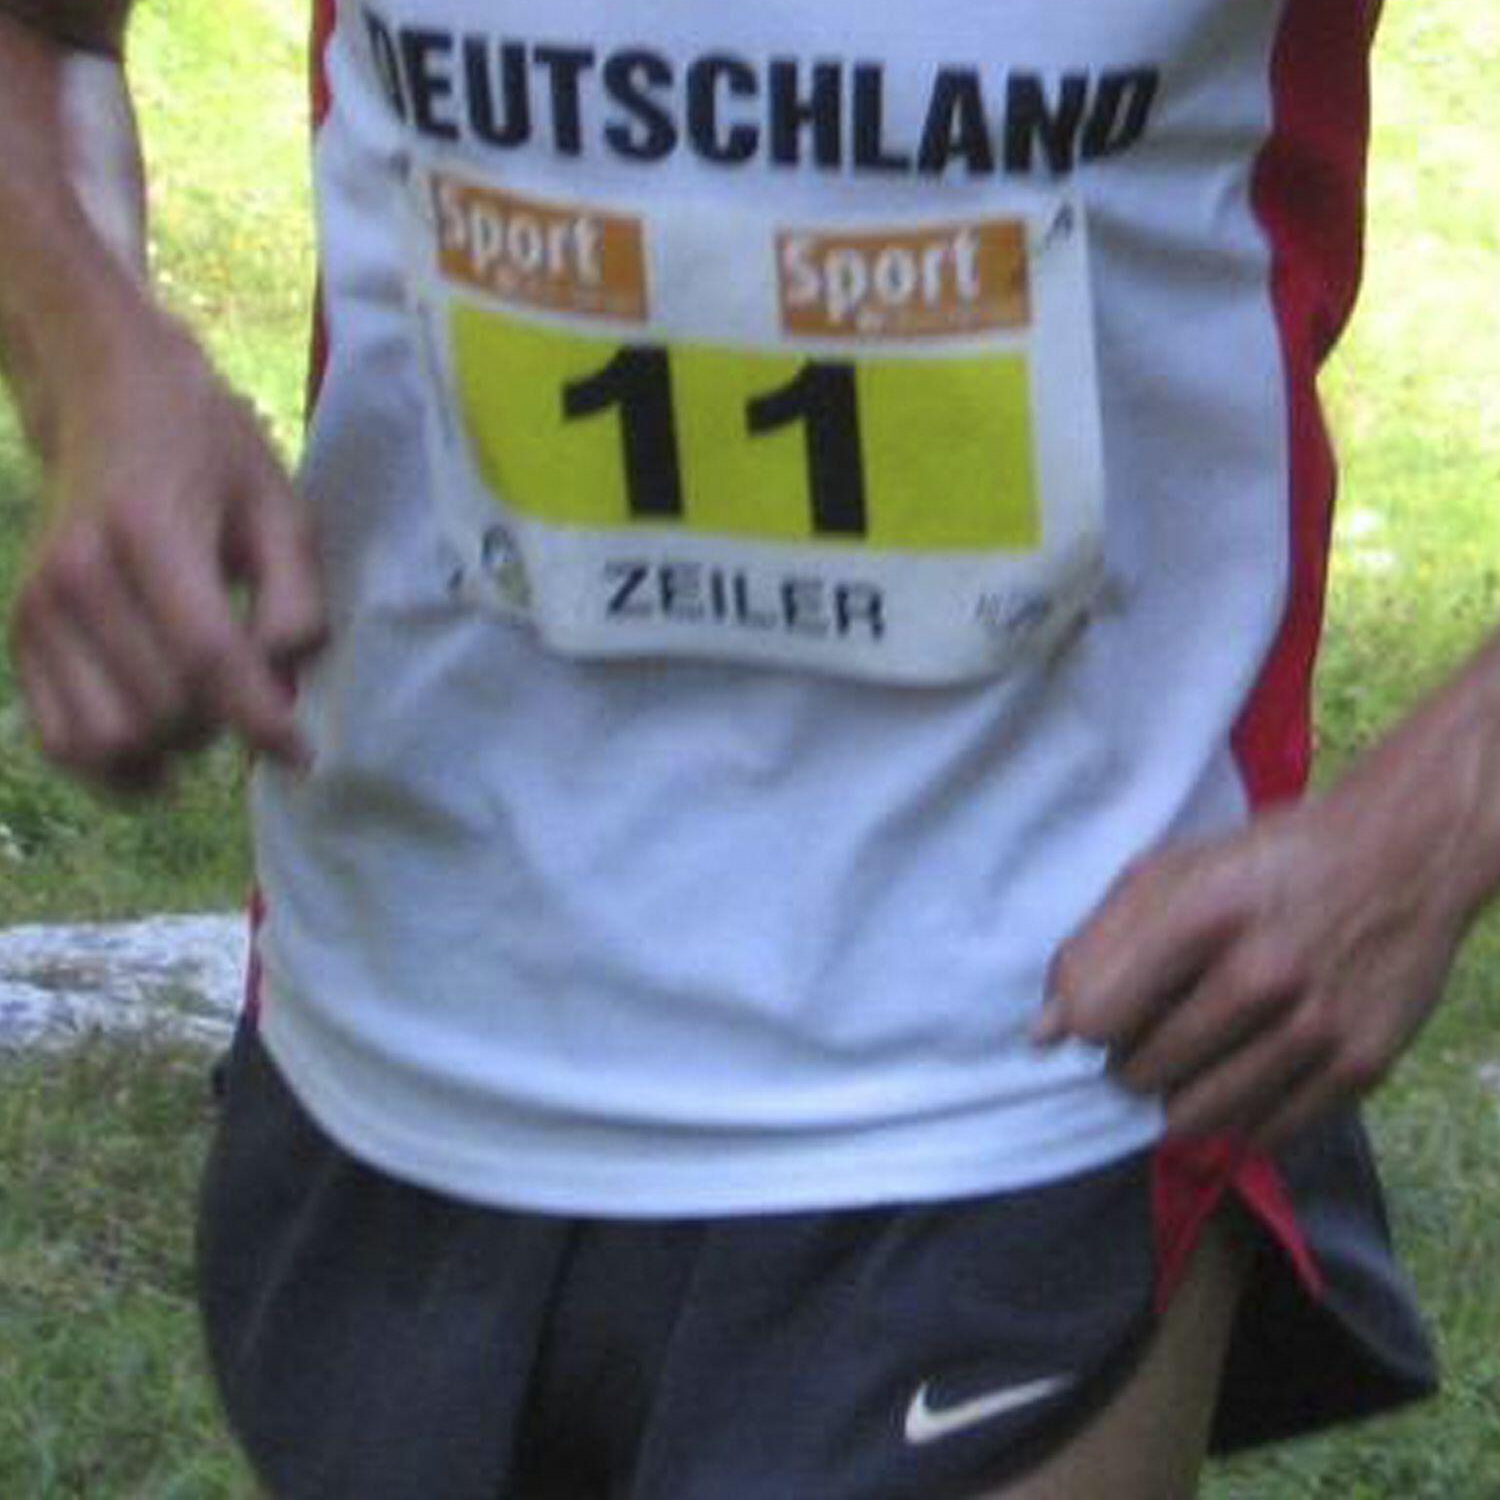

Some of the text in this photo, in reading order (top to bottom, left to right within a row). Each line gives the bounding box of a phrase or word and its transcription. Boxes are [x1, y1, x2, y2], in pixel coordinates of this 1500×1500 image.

[365, 7, 1161, 175] DEUTSCHLAND
[438, 184, 980, 324] Sport Sport
[563, 345, 868, 541] 11
[604, 560, 886, 642] ZEILER
